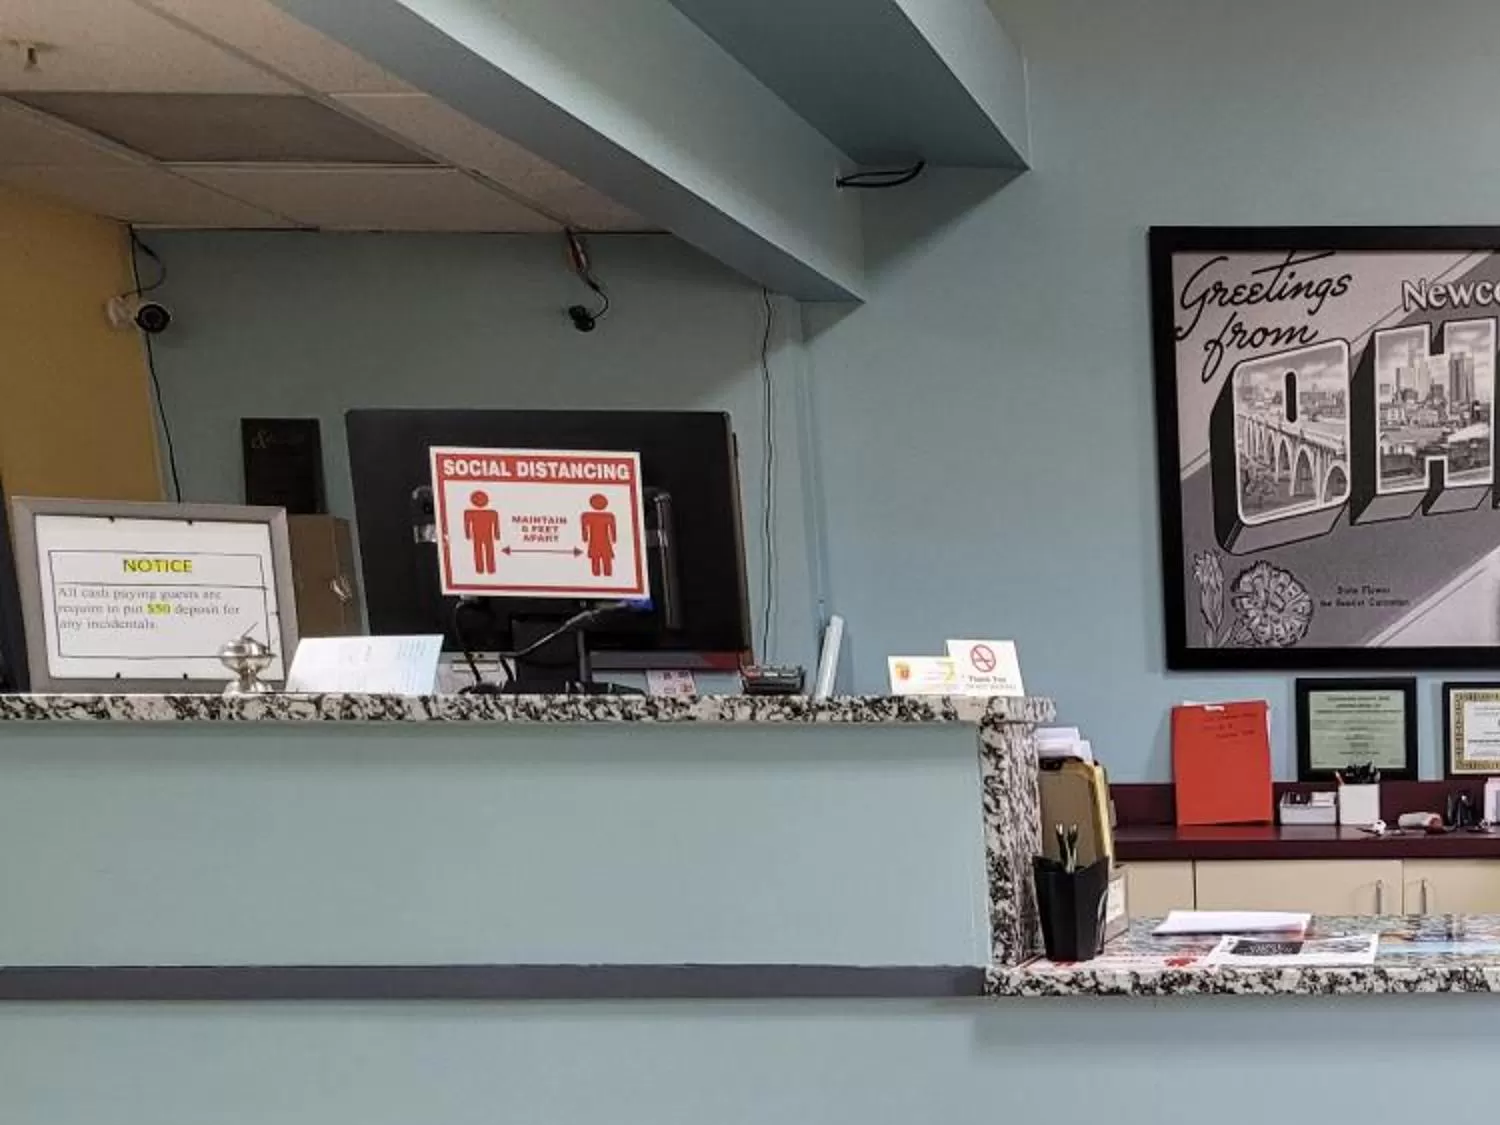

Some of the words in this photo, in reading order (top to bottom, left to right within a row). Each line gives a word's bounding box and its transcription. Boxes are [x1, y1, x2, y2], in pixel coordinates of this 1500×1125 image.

[1175, 249, 1353, 341] Greetings
[1202, 311, 1319, 385] from
[443, 459, 512, 477] SOCIAL
[515, 461, 630, 480] DISTANCING
[511, 515, 567, 525] MAINTAIN
[531, 525, 559, 533] FEET
[523, 533, 559, 543] APART
[122, 559, 193, 573] NOTICE
[58, 587, 78, 599] All
[81, 587, 110, 600] cash
[222, 603, 241, 615] for
[59, 619, 83, 632] any
